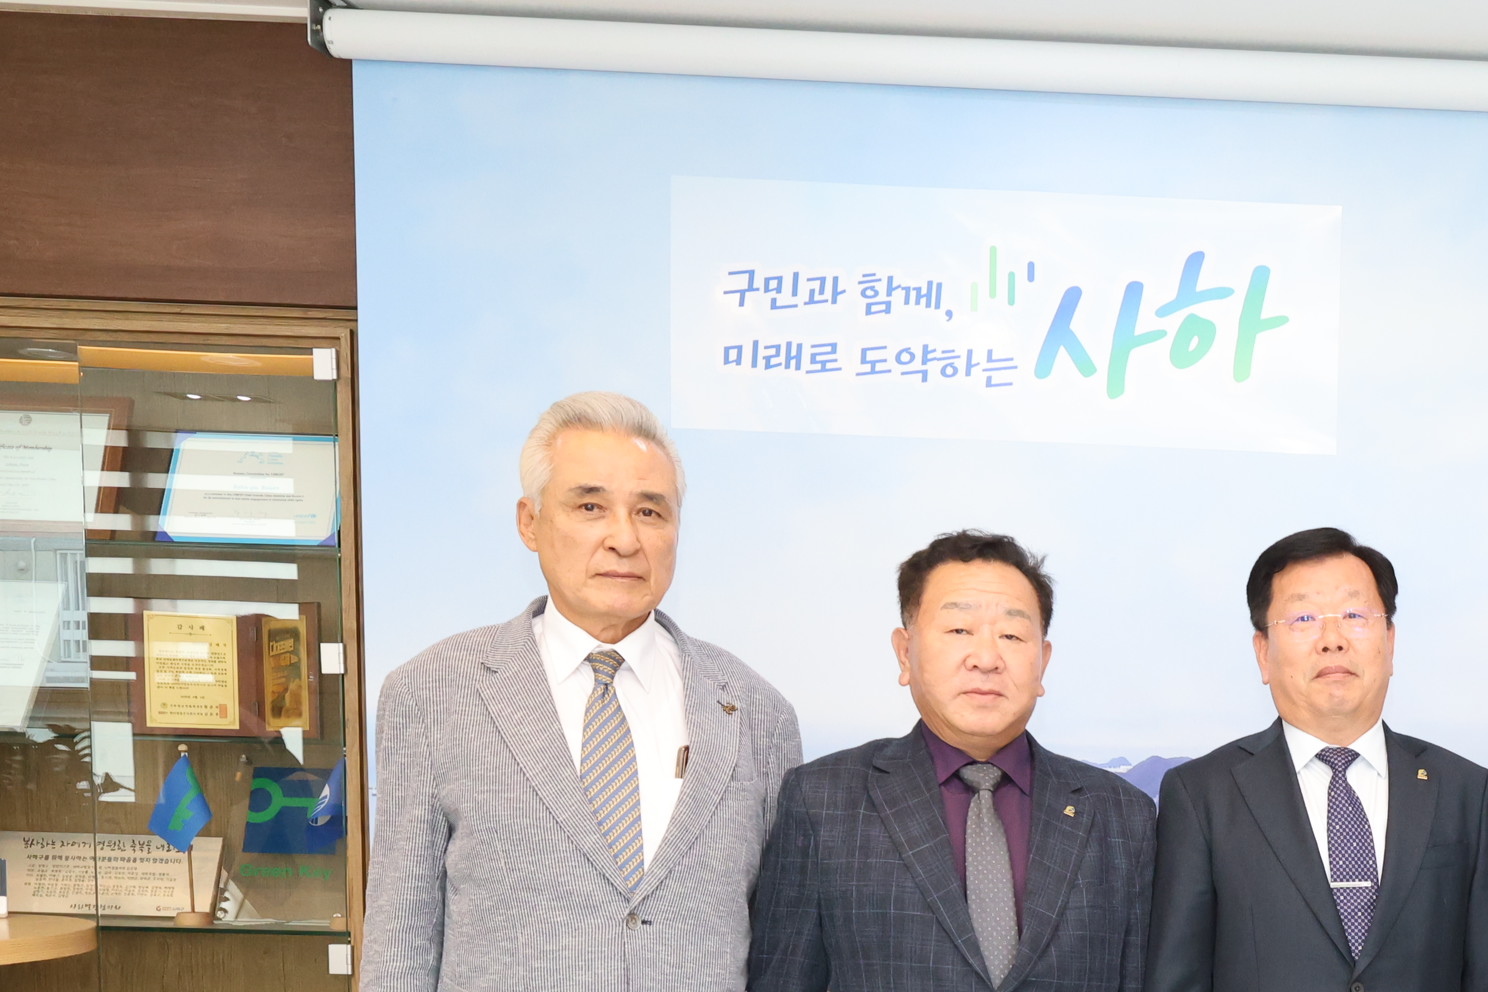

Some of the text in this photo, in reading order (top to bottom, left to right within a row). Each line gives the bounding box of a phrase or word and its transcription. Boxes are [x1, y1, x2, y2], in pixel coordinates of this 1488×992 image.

[722, 268, 955, 322] 구민과 함께,
[1033, 250, 1291, 399] 사하
[722, 337, 1019, 389] 미래로 도약하는
[239, 863, 335, 881] Green Key
